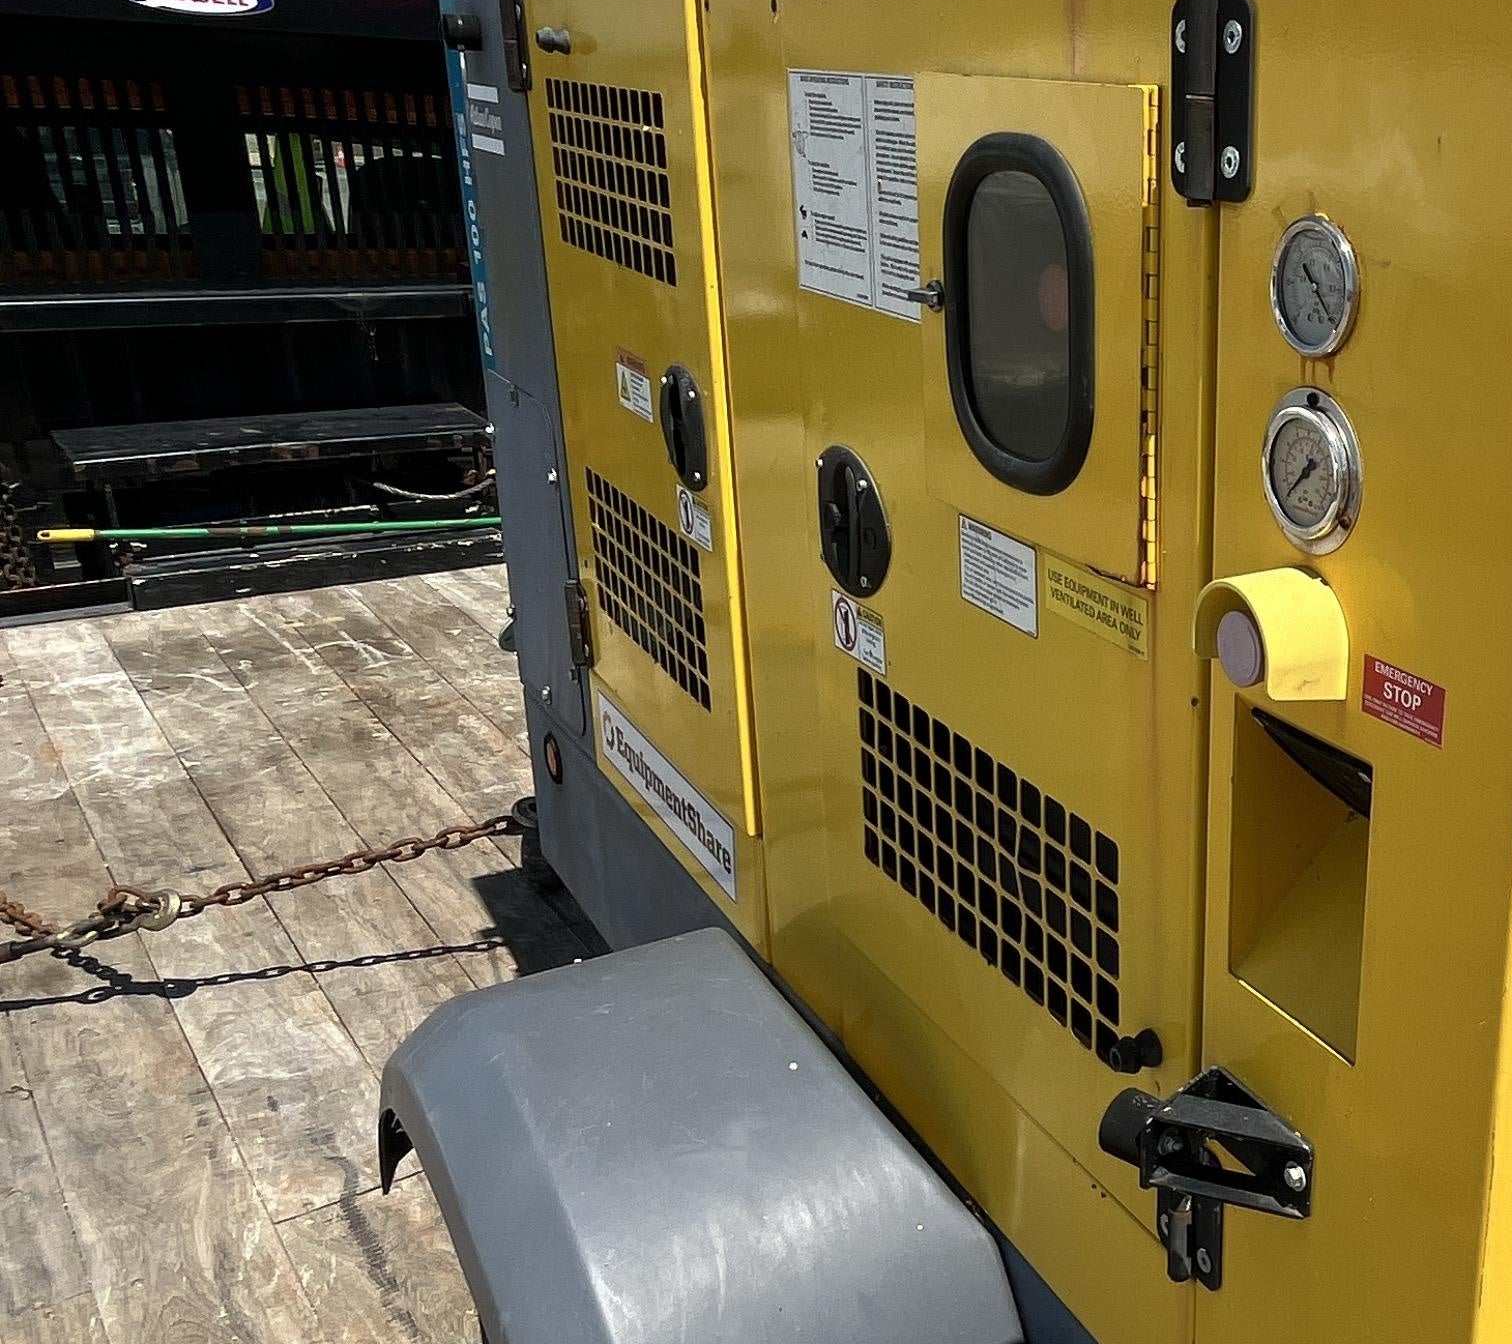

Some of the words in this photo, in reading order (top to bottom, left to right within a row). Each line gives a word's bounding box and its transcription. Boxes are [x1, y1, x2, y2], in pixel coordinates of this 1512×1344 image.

[467, 198, 482, 265] 100
[476, 280, 493, 357] PAS
[1047, 568, 1063, 586] USE
[1064, 576, 1109, 608] EQUIPMENT
[1110, 599, 1119, 615] IN
[1120, 603, 1144, 626] WELL
[1050, 586, 1096, 619] VENTILATED
[1096, 610, 1118, 631] AREA
[1119, 621, 1142, 641] ONLY
[1374, 660, 1434, 696] EMERGENCY
[1383, 681, 1422, 711] STOP
[615, 725, 732, 875] EquipmentShare
